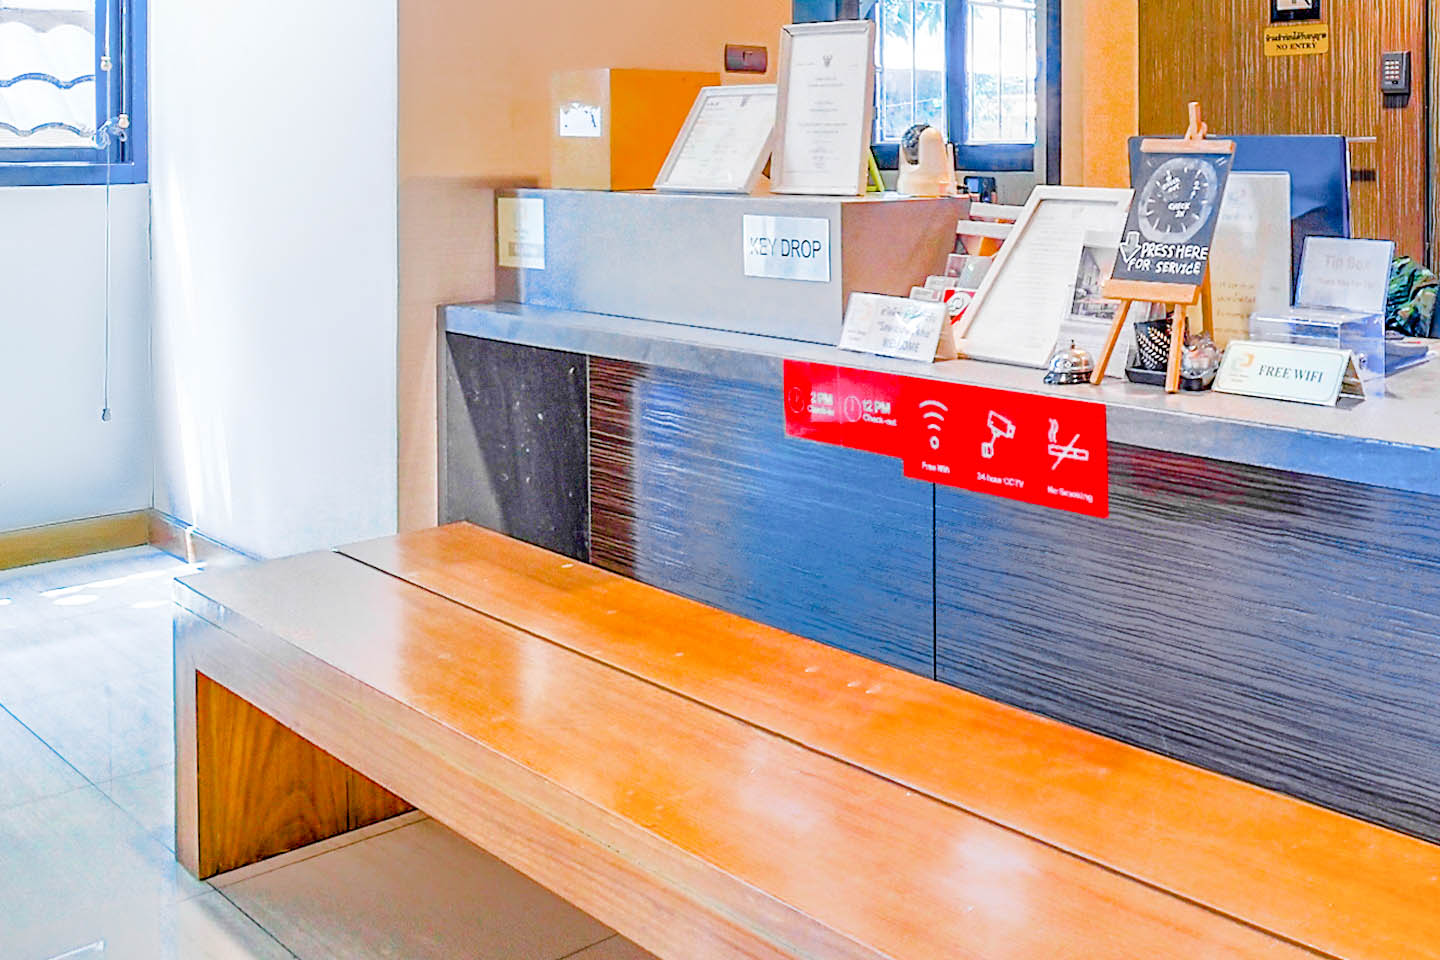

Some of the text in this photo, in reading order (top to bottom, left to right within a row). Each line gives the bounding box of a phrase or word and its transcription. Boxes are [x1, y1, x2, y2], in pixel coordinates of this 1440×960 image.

[1290, 41, 1317, 50] ENTRY
[750, 236, 822, 258] KEY DROP
[1140, 242, 1209, 260] PRESS HERE
[1127, 258, 1202, 275] FOR SERVICE
[1258, 364, 1292, 379] FREE
[1294, 368, 1324, 384] WIFI
[817, 392, 834, 405] PM
[862, 399, 891, 415] 12 PM
[921, 461, 936, 471] Free
[976, 471, 987, 481] 24
[1003, 477, 1025, 488] CCTV
[1047, 485, 1093, 504] No Smoking
